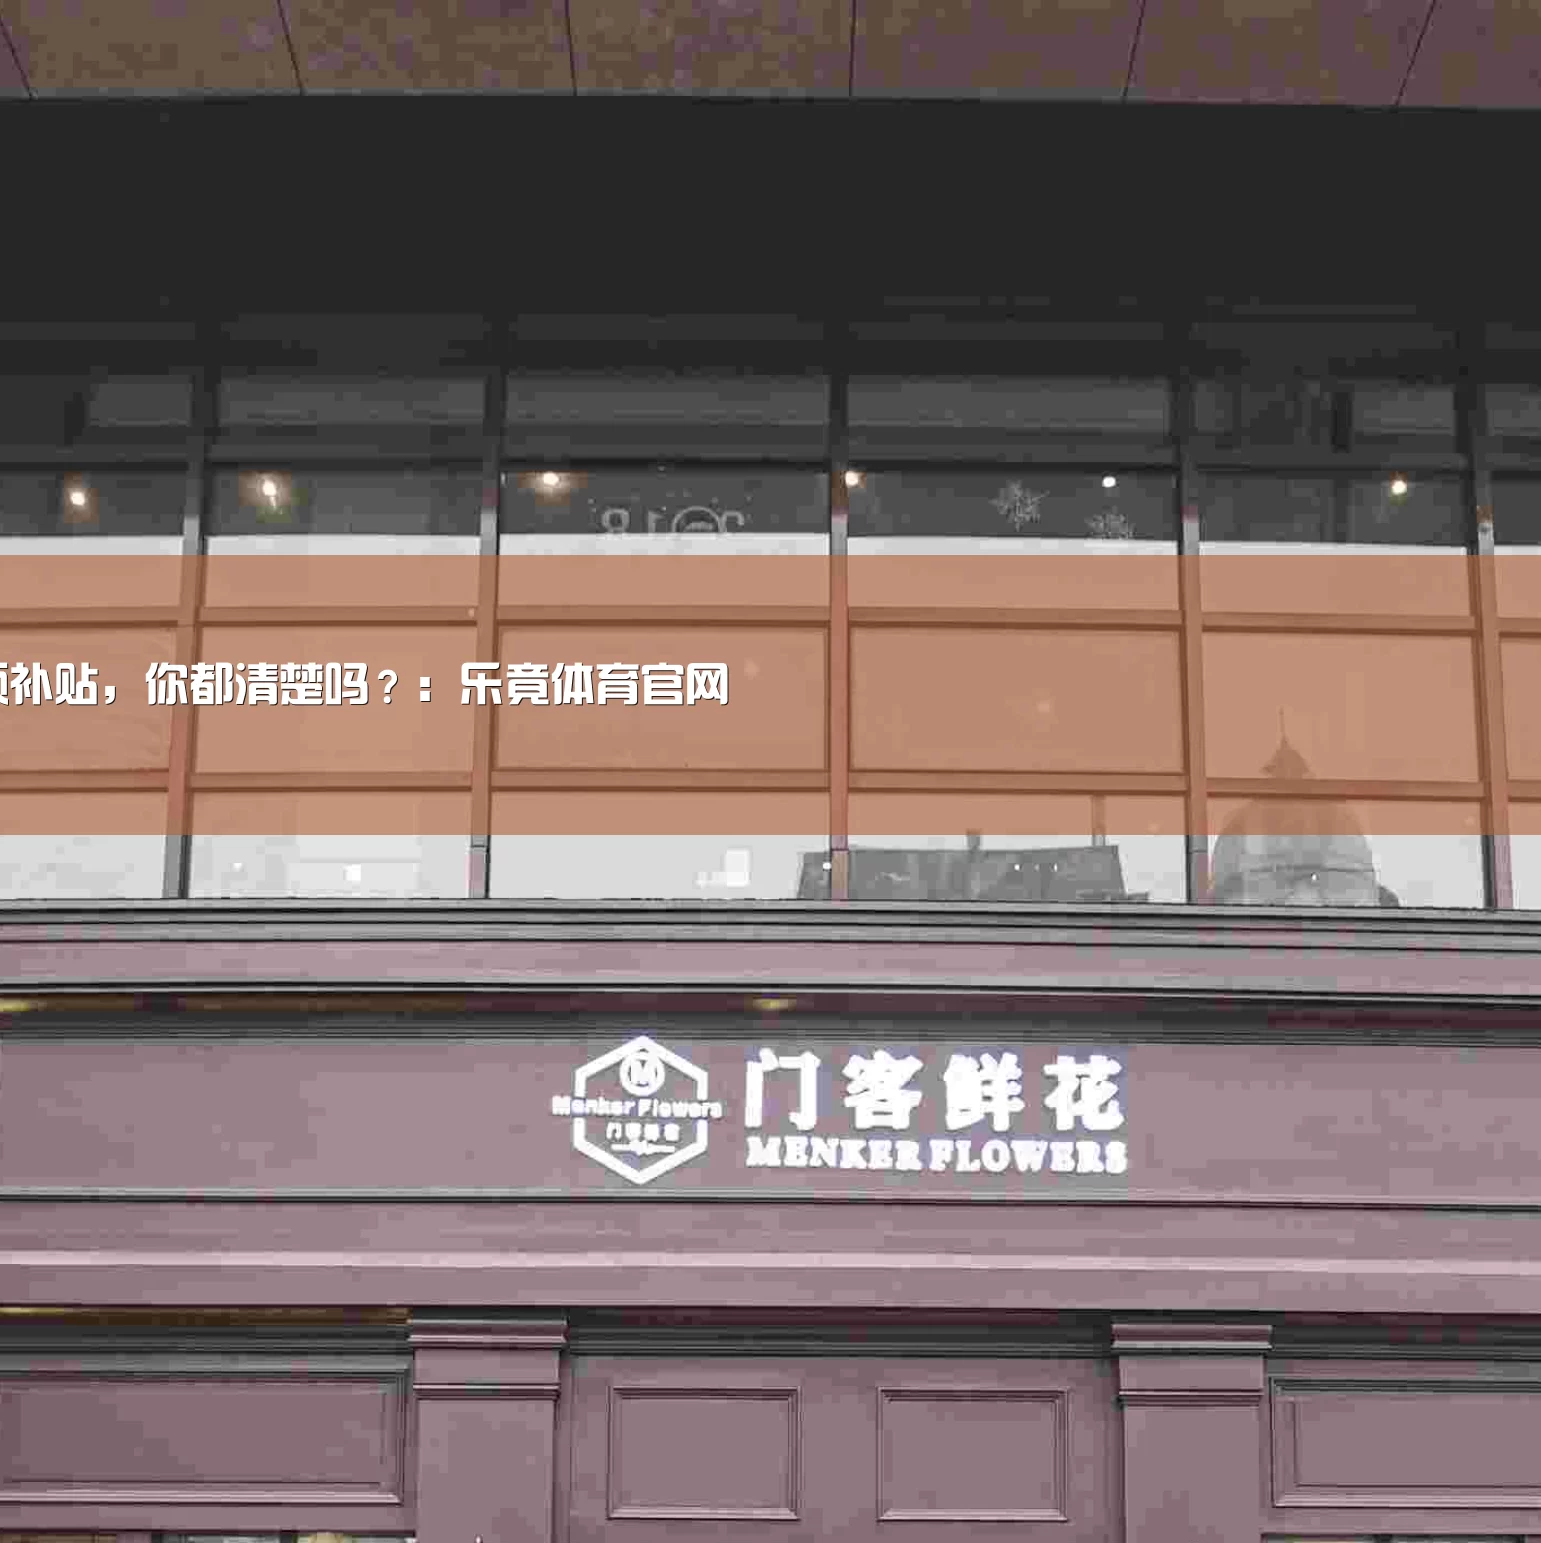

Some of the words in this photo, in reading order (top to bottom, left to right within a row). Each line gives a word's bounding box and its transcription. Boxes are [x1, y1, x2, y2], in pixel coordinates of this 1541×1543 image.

[744, 1048, 1125, 1131] 门客鲜花
[745, 1136, 922, 1168] MENKER
[928, 1139, 1128, 1174] FLOWERS
